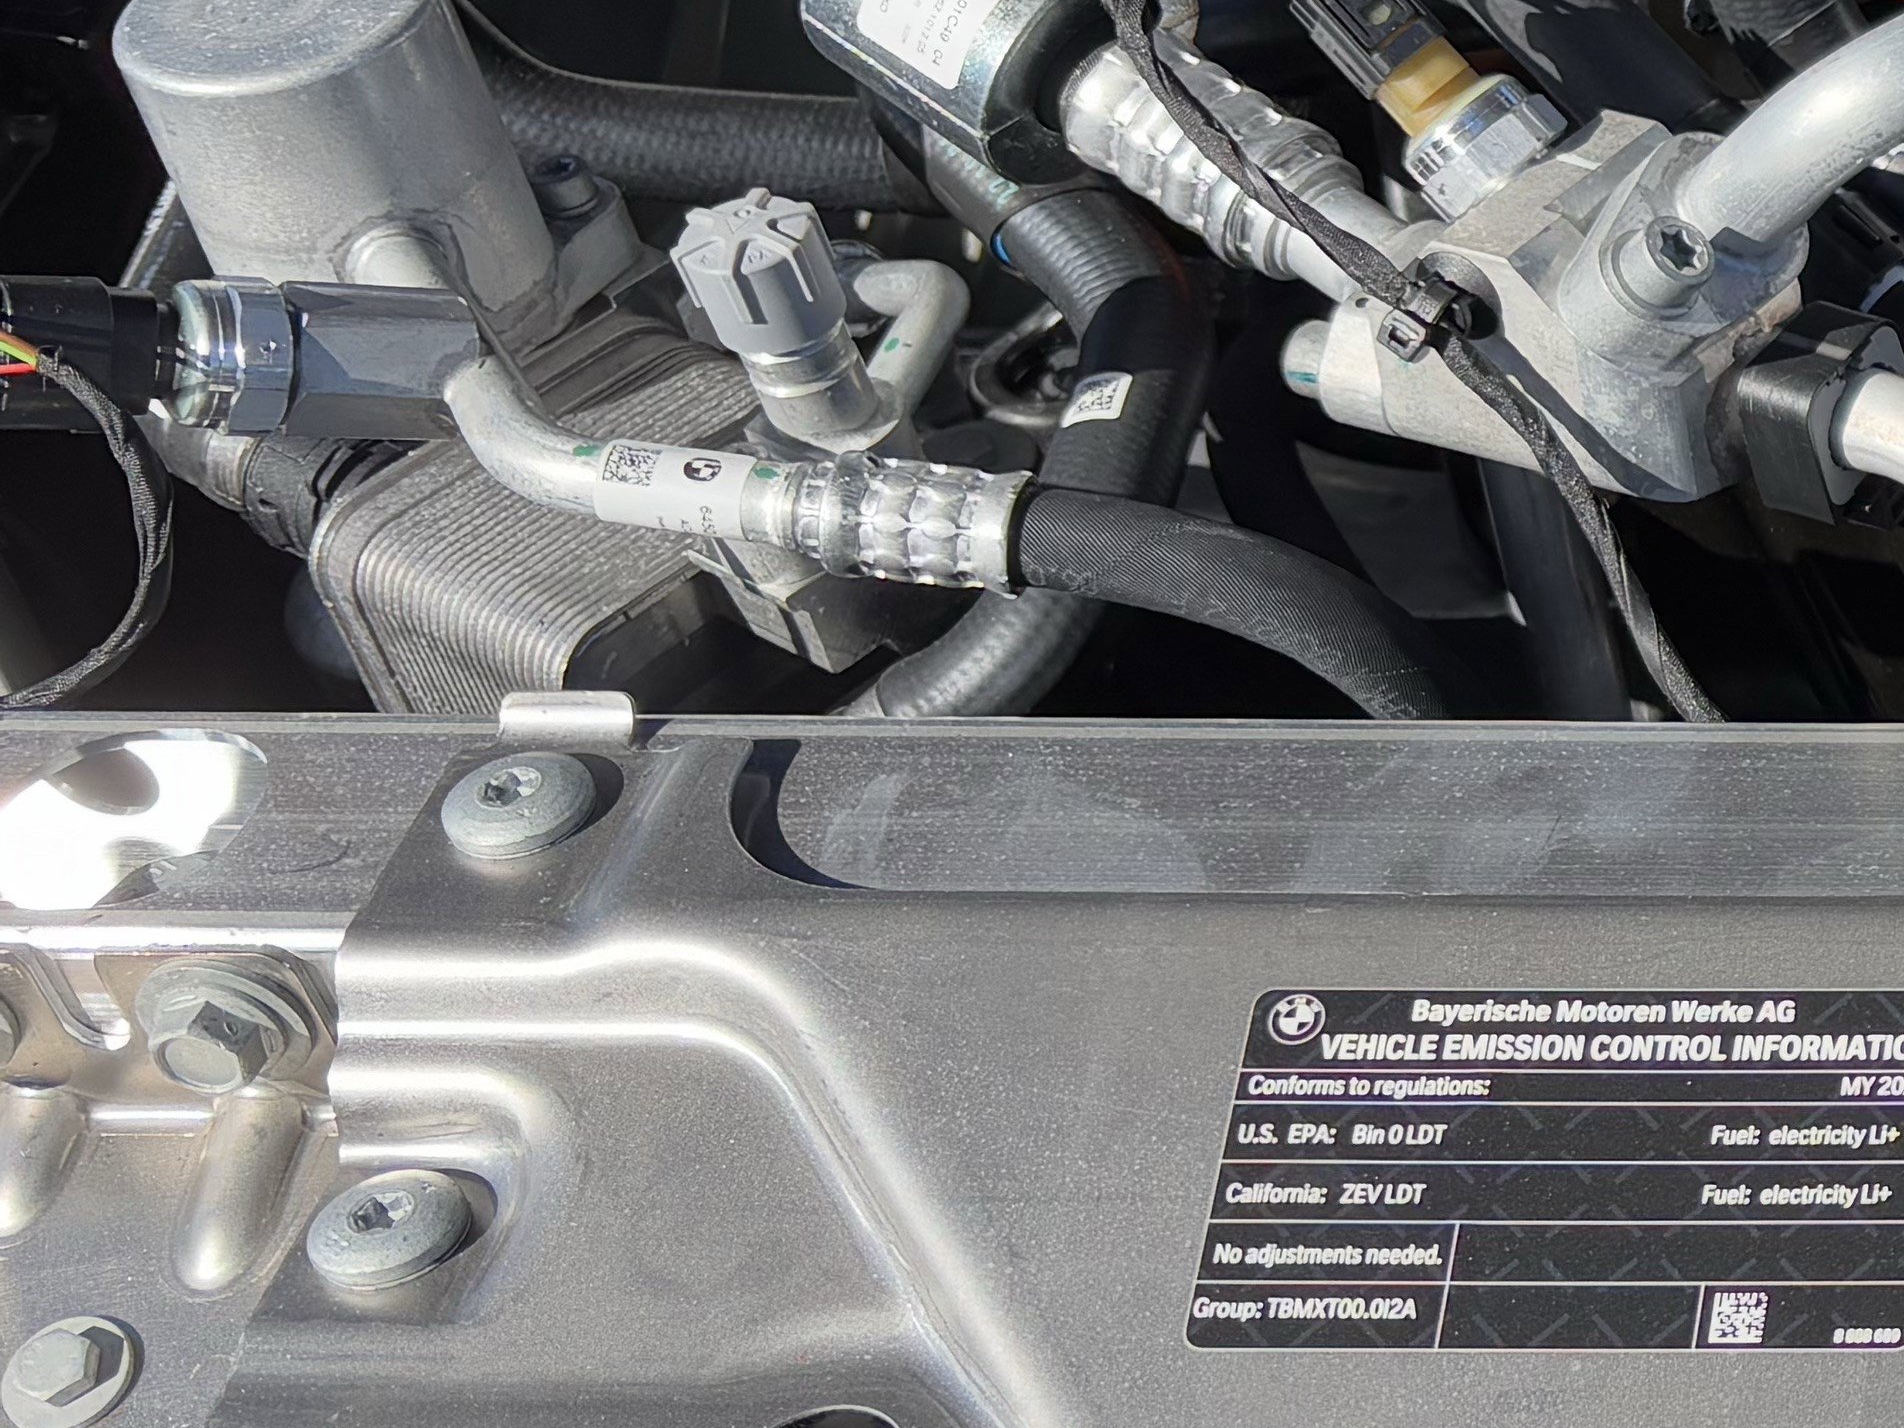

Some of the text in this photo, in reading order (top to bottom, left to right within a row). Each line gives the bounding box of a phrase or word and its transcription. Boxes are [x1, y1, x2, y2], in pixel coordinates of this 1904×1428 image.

[1411, 999, 1796, 1027] Bayerische Motoren Werke AG
[1321, 1033, 1440, 1062] VEHICLE
[1442, 1034, 1586, 1062] EMISSION
[1589, 1034, 1727, 1062] CONTROL
[1248, 1075, 1346, 1096] Conforms
[1350, 1076, 1371, 1096] to
[1374, 1075, 1491, 1100] regulations:
[1840, 1076, 1876, 1097] MY
[1238, 1123, 1279, 1144] U.S.
[1287, 1123, 1337, 1145] EPA:
[1352, 1124, 1386, 1145] Bin
[1406, 1124, 1448, 1145] LDT
[1710, 1124, 1761, 1146] Fuel:
[1768, 1125, 1868, 1149] electricity
[1869, 1124, 1901, 1146] Li+
[1225, 1182, 1893, 1209] California: ZEV LDT Fuel: electricity Li+
[1212, 1243, 1443, 1268] No adjustments needed.
[1193, 1296, 1263, 1322] Group:
